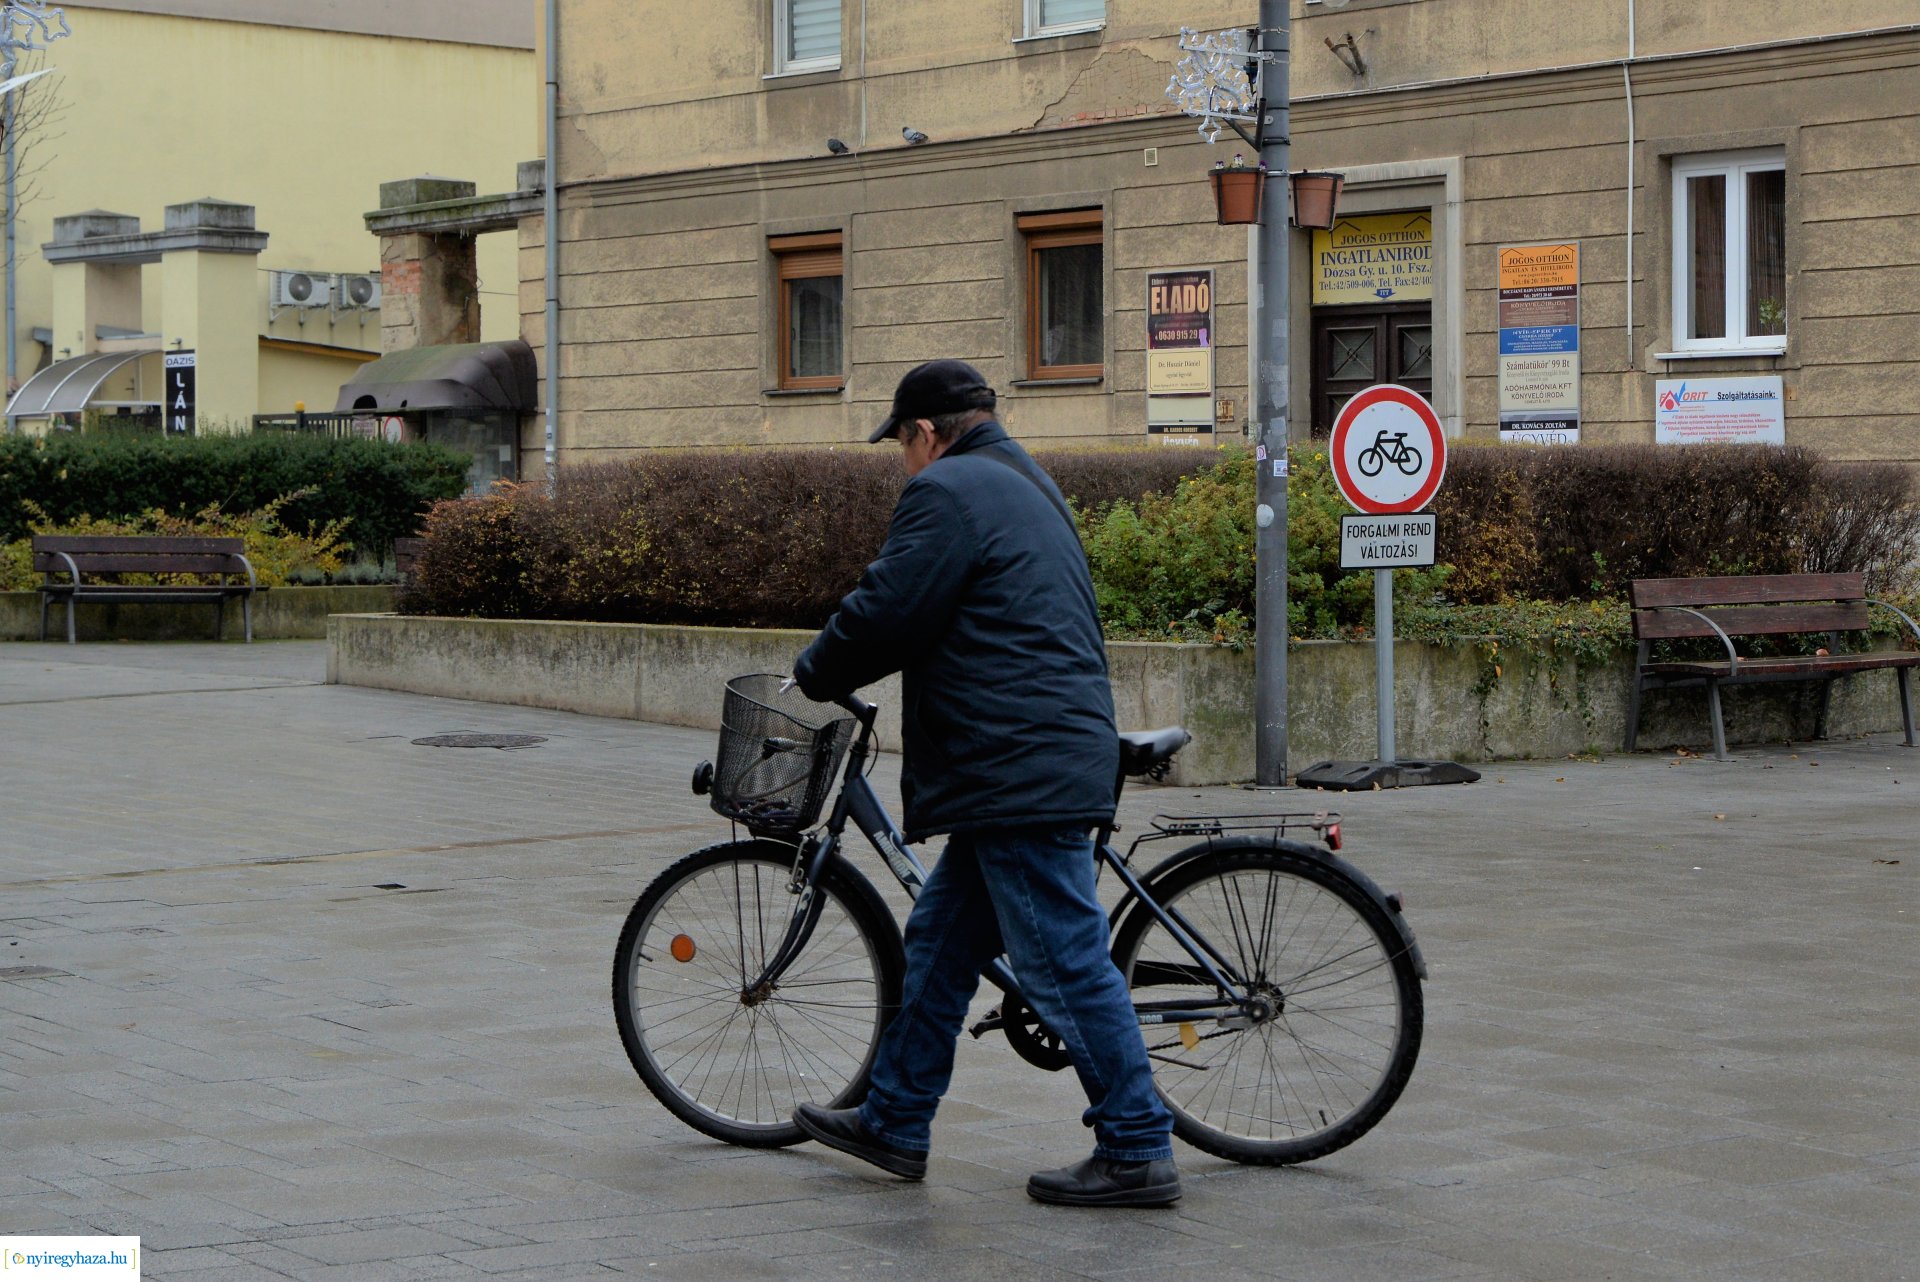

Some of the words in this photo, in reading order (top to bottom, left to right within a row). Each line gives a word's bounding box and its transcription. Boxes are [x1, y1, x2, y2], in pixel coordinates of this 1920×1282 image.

[1341, 233, 1377, 245] JOGOS
[1379, 230, 1425, 242] OTTHON
[1508, 256, 1534, 265] JOGOS
[1536, 254, 1570, 263] OTTHON
[1324, 267, 1356, 278] Dózsa
[1359, 265, 1375, 278] Gy.
[1378, 267, 1388, 275] u.
[1391, 264, 1405, 274] 10.
[1151, 278, 1209, 315] ELADÓ
[1504, 383, 1557, 392] ADÓHARMÓNIA
[1558, 382, 1572, 390] KFT
[1717, 390, 1776, 401] Szolgáltatásaink:
[1522, 421, 1544, 429] KOVÁCS
[1545, 421, 1567, 429] ZOLTÁN
[1347, 523, 1400, 539] FORGALMI
[1403, 522, 1431, 537] REND
